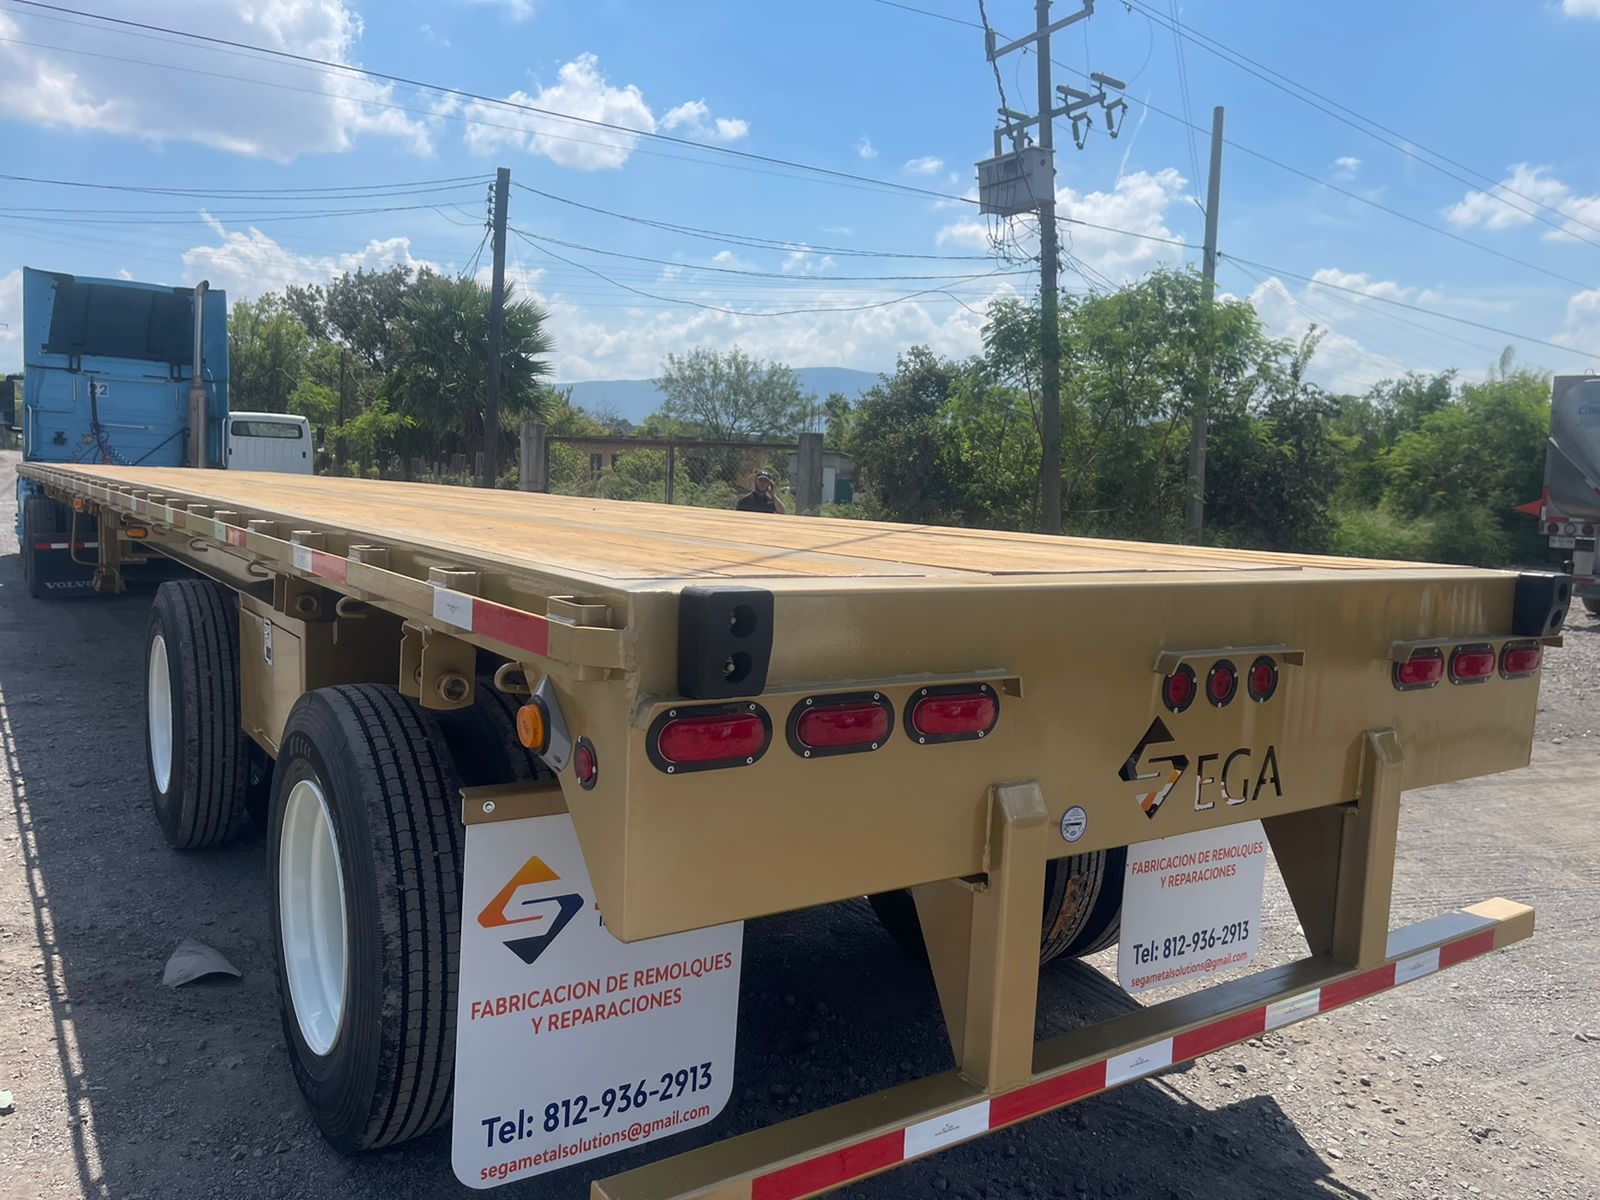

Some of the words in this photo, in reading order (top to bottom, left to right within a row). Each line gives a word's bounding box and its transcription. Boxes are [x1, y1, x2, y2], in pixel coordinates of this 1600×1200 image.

[1131, 849, 1197, 875] FABRICACION
[1198, 848, 1211, 864] DE
[1212, 840, 1264, 863] REMOLQUES
[1159, 876, 1167, 889] Y
[1167, 863, 1237, 888] REPARACIONES
[1133, 940, 1159, 965] Tel:
[1163, 920, 1250, 959] 812-936-2913
[470, 979, 602, 1021] FABRICACION
[605, 972, 629, 994] DE
[633, 951, 733, 989] REMOLQUES
[1130, 950, 1248, 988] segametalsolutions@gmail.com
[531, 1016, 544, 1035] Y
[547, 986, 682, 1033] REPARACIONES
[481, 1108, 534, 1148] Tel:
[543, 1061, 713, 1133] 812-936-2913
[479, 1103, 711, 1180] segametalsolutions@gmail.com
